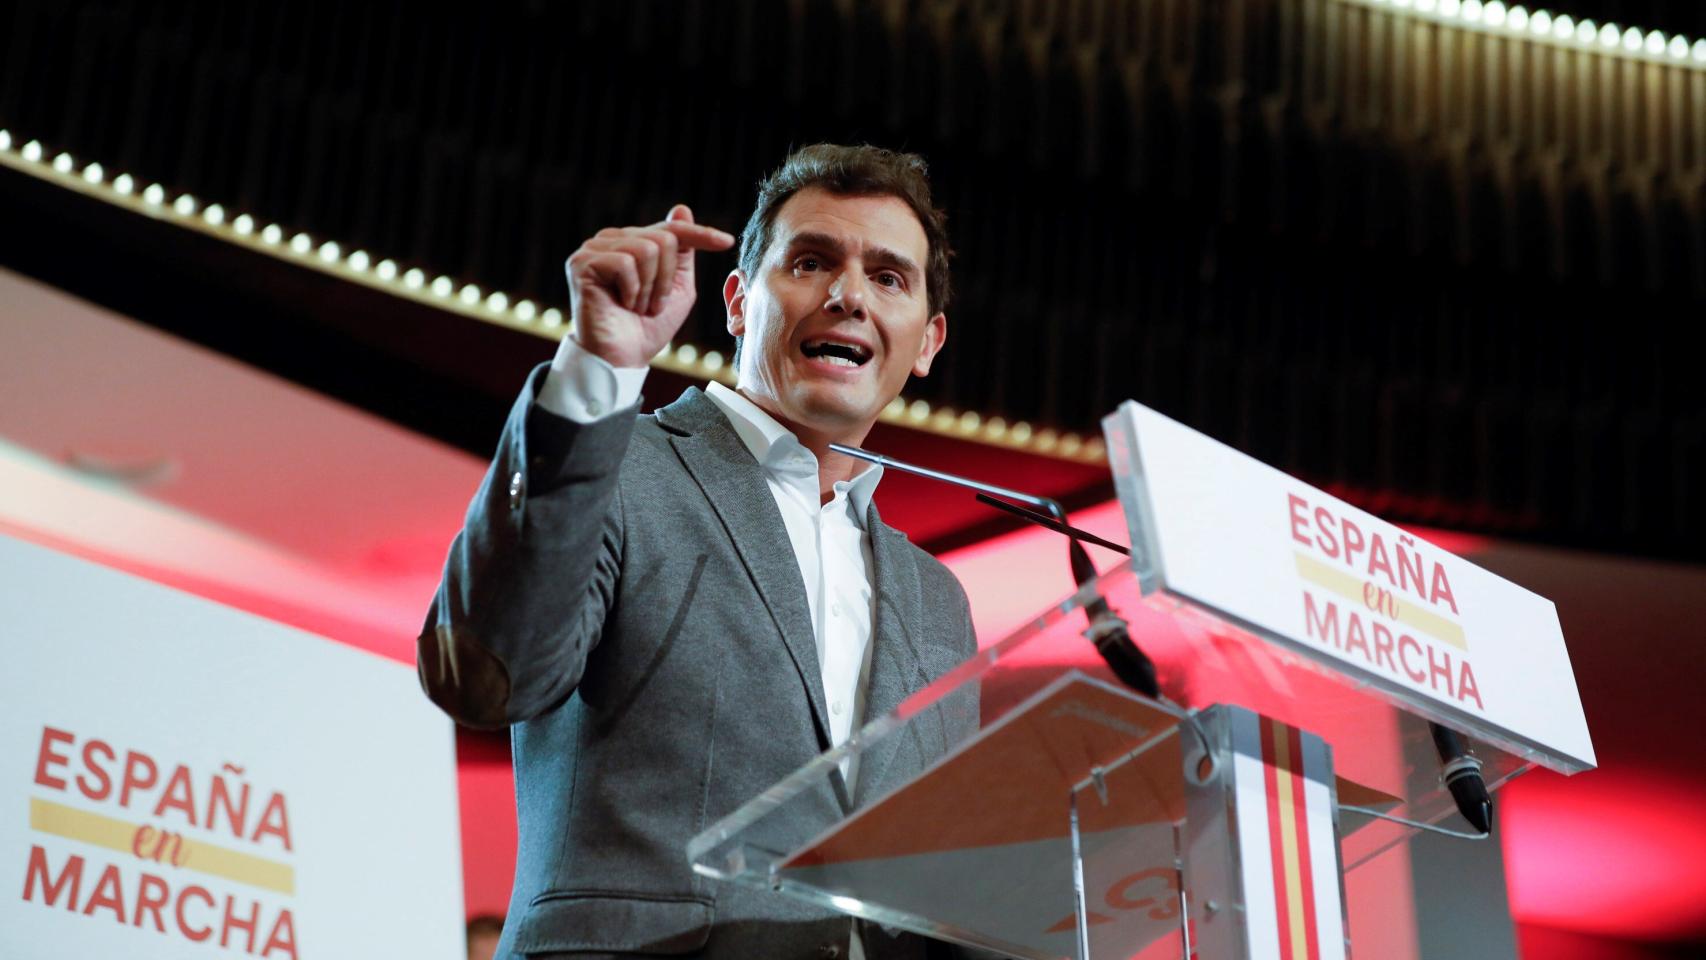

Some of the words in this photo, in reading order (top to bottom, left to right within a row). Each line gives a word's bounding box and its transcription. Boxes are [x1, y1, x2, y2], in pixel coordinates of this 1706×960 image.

[1288, 493, 1459, 615] ESPAÑA
[1363, 581, 1400, 621] en
[1304, 591, 1484, 710] MARCHA
[35, 726, 293, 851] ESPAÑA
[132, 823, 188, 868] en
[22, 845, 300, 960] MARCHA
